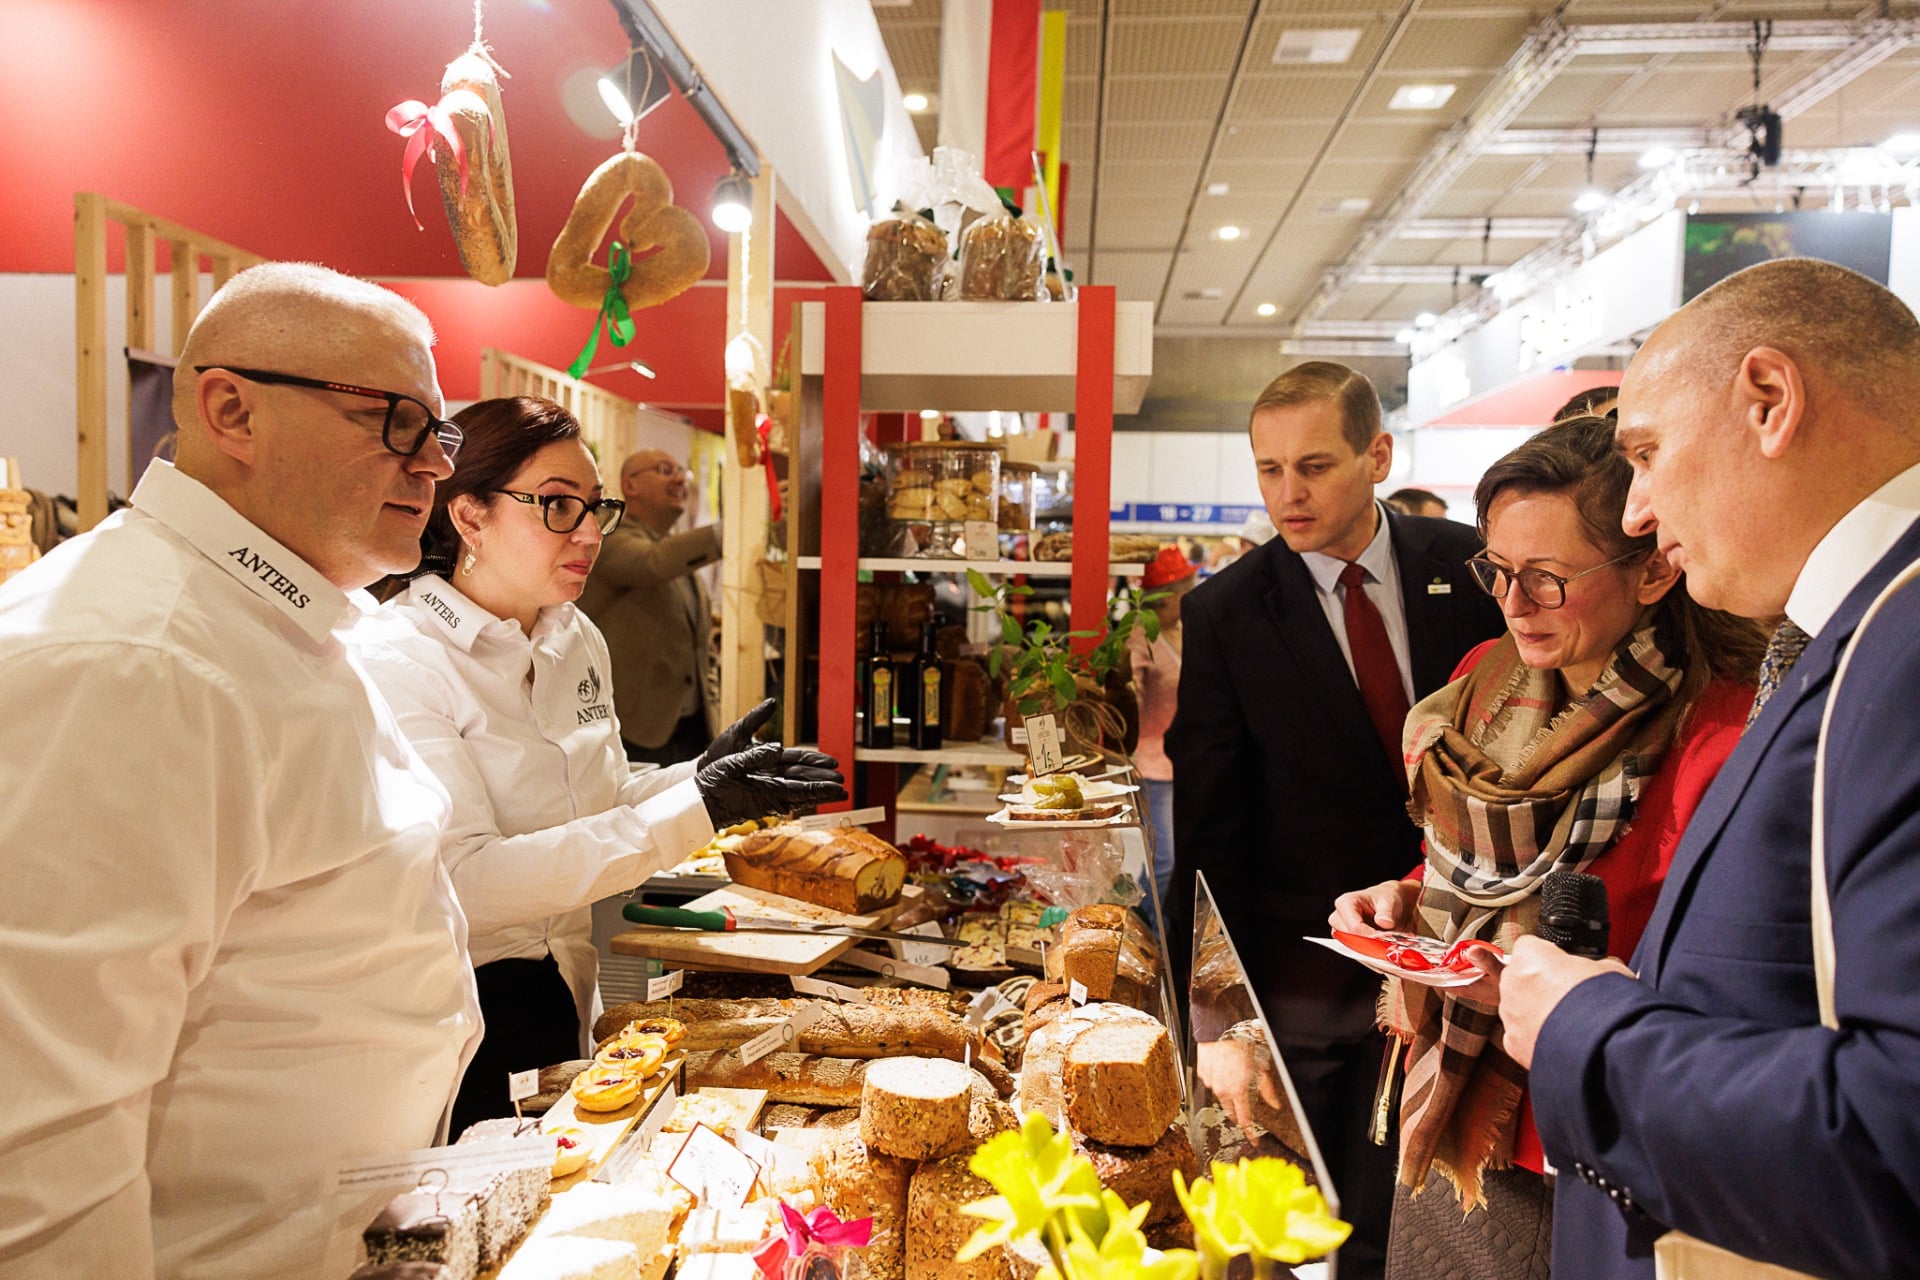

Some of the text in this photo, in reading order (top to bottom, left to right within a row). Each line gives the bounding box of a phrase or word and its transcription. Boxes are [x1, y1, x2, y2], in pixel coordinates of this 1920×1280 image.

[228, 547, 311, 609] ANTERS
[420, 592, 461, 629] ANTERS
[576, 704, 610, 725] ANTER
